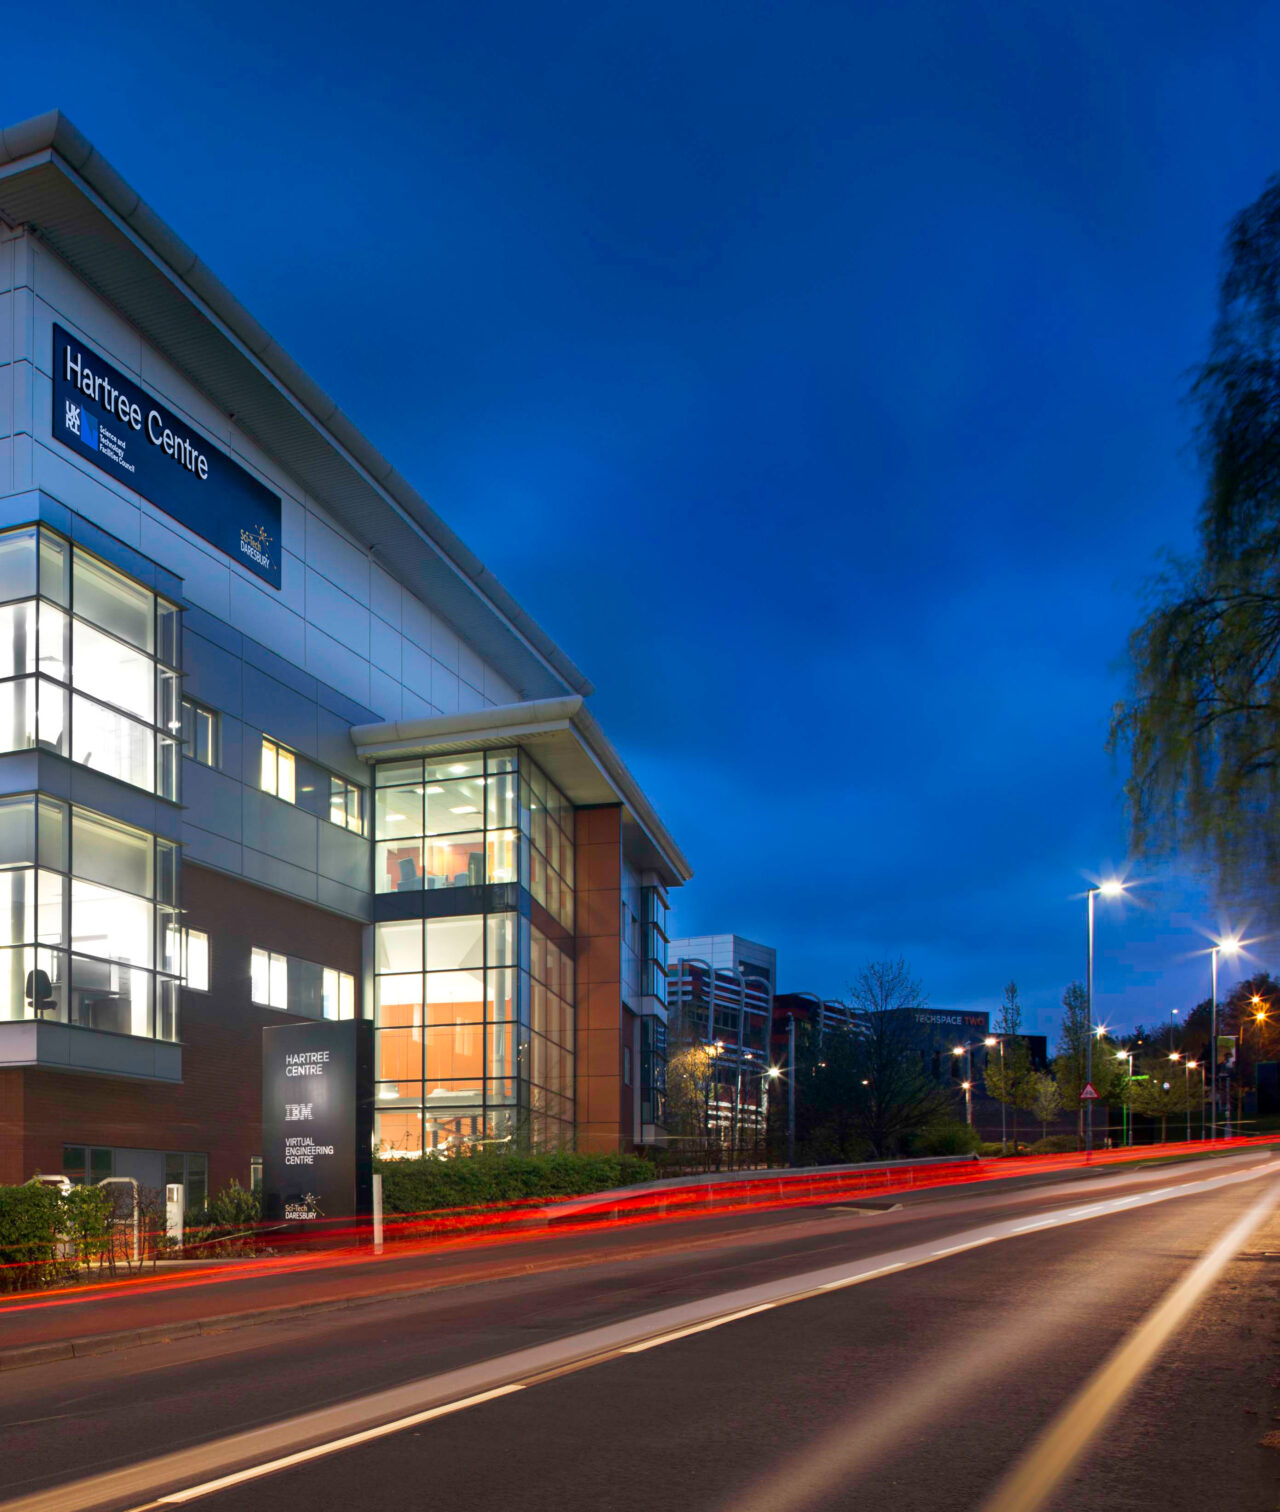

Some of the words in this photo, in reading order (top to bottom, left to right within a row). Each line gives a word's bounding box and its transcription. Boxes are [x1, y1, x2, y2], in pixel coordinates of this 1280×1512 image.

[66, 345, 142, 430] Hartree
[148, 410, 208, 480] Centre
[100, 425, 117, 443] Science
[100, 434, 125, 458] Technology
[119, 456, 135, 473] Council
[240, 529, 261, 552] Sci-Tech
[240, 540, 269, 568] DARESBURY
[915, 1014, 962, 1025] TECHSPACE
[964, 1015, 985, 1026] TWO
[285, 1051, 330, 1065] HARTREE
[285, 1063, 323, 1077] CENTRE
[285, 1103, 313, 1121] IBM
[285, 1137, 315, 1147] VIRTUAL
[285, 1146, 334, 1156] ENGINEERING
[285, 1155, 314, 1165] CENTRE
[285, 1203, 308, 1212] Sci-Tech
[285, 1211, 317, 1220] DARESBURY
